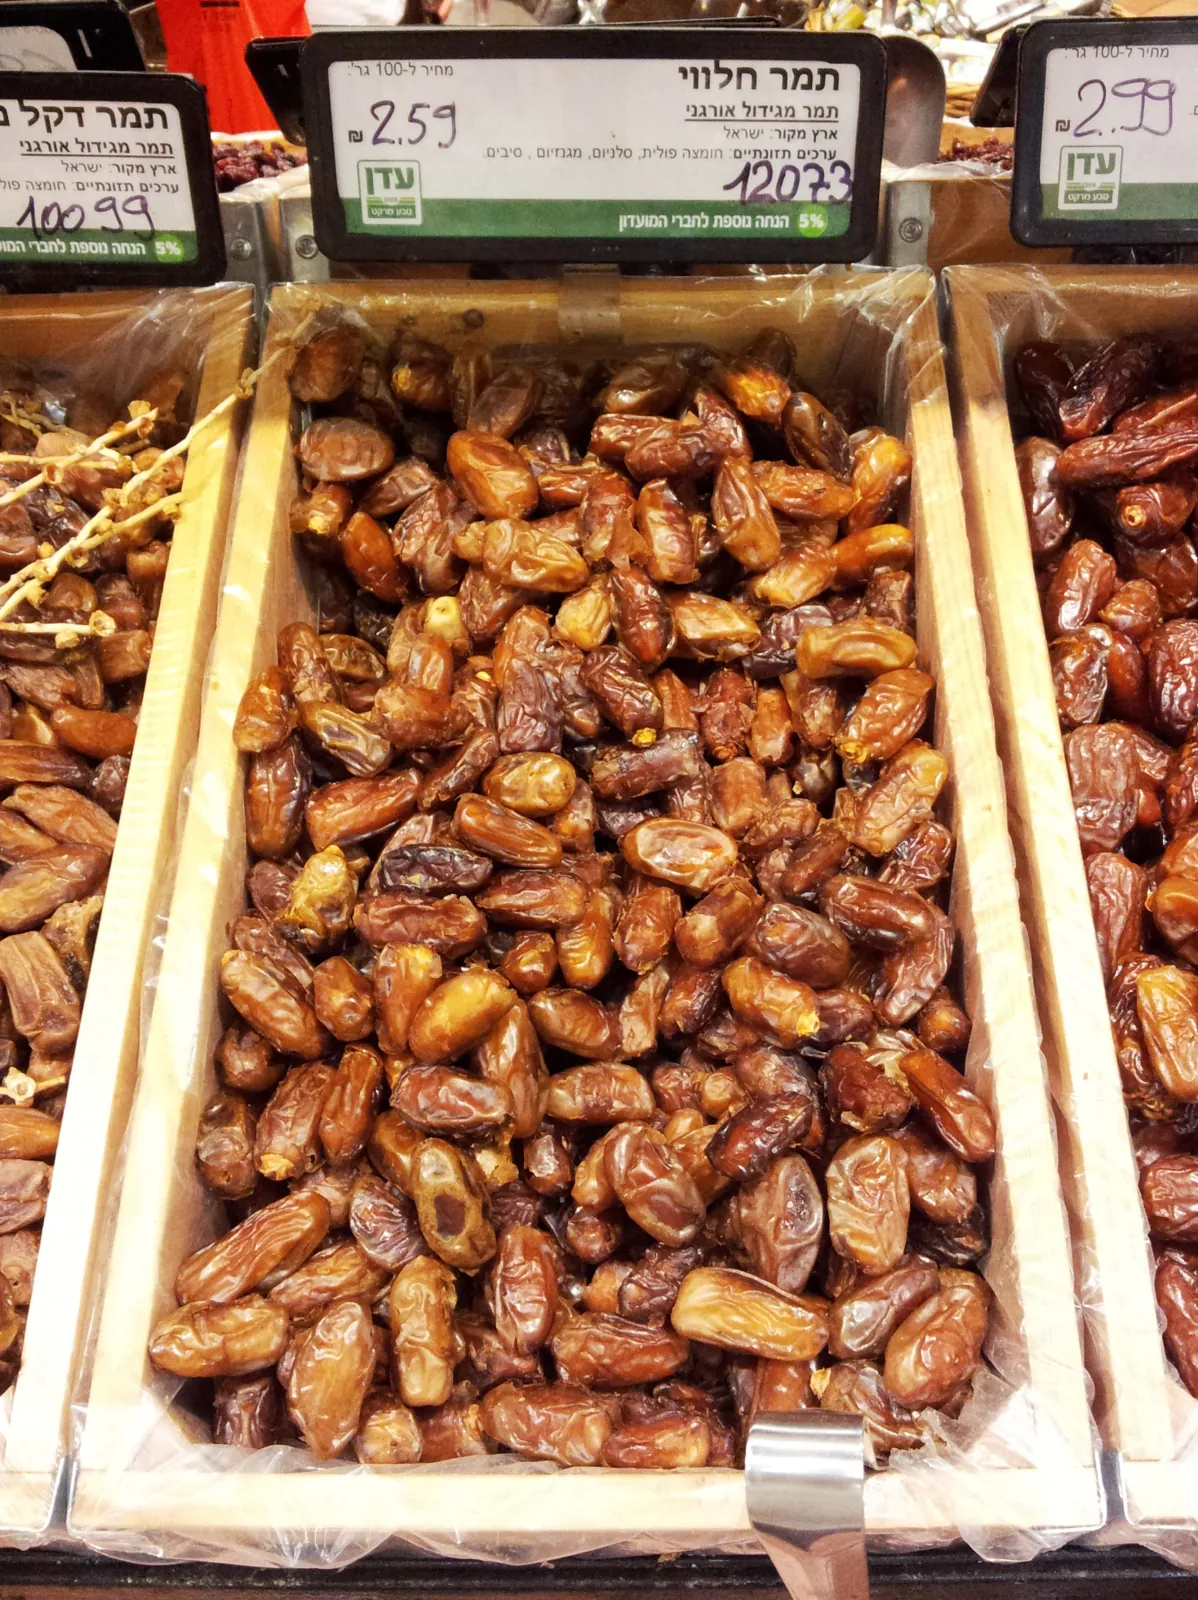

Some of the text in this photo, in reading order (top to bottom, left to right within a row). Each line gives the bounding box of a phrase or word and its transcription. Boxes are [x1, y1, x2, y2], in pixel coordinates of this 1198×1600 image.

[1137, 47, 1170, 58] מחיר
[376, 61, 417, 76] ל-100
[421, 64, 454, 76] מחיר
[678, 59, 840, 91] תמר חלווי
[18, 99, 85, 134] דקל
[686, 101, 839, 119] תמר מגידול אורגני
[96, 106, 169, 130] תמר
[370, 100, 457, 149] 2.59
[724, 126, 764, 140] ישראל
[811, 128, 838, 143] ארץ
[20, 138, 174, 155] תמר מגידול אורגני
[588, 145, 633, 160] סלניום,
[638, 146, 677, 160] פולית,
[682, 149, 723, 160] חומצה
[796, 149, 837, 161] ערכים
[61, 160, 102, 173] ישראל
[150, 164, 177, 177] ארץ
[1067, 153, 1117, 181] עדן
[25, 180, 66, 191] חומצה
[140, 182, 179, 193] ערכים
[364, 167, 415, 195] עדן
[723, 159, 852, 206] 12073
[1068, 192, 1110, 202] טבע מרקט
[371, 207, 413, 217] טבע מרקט
[619, 212, 825, 232] 5% הנחה נוספת לחברי המועדון
[0, 238, 181, 255] 5% הנחה נוספת לחברי המו
